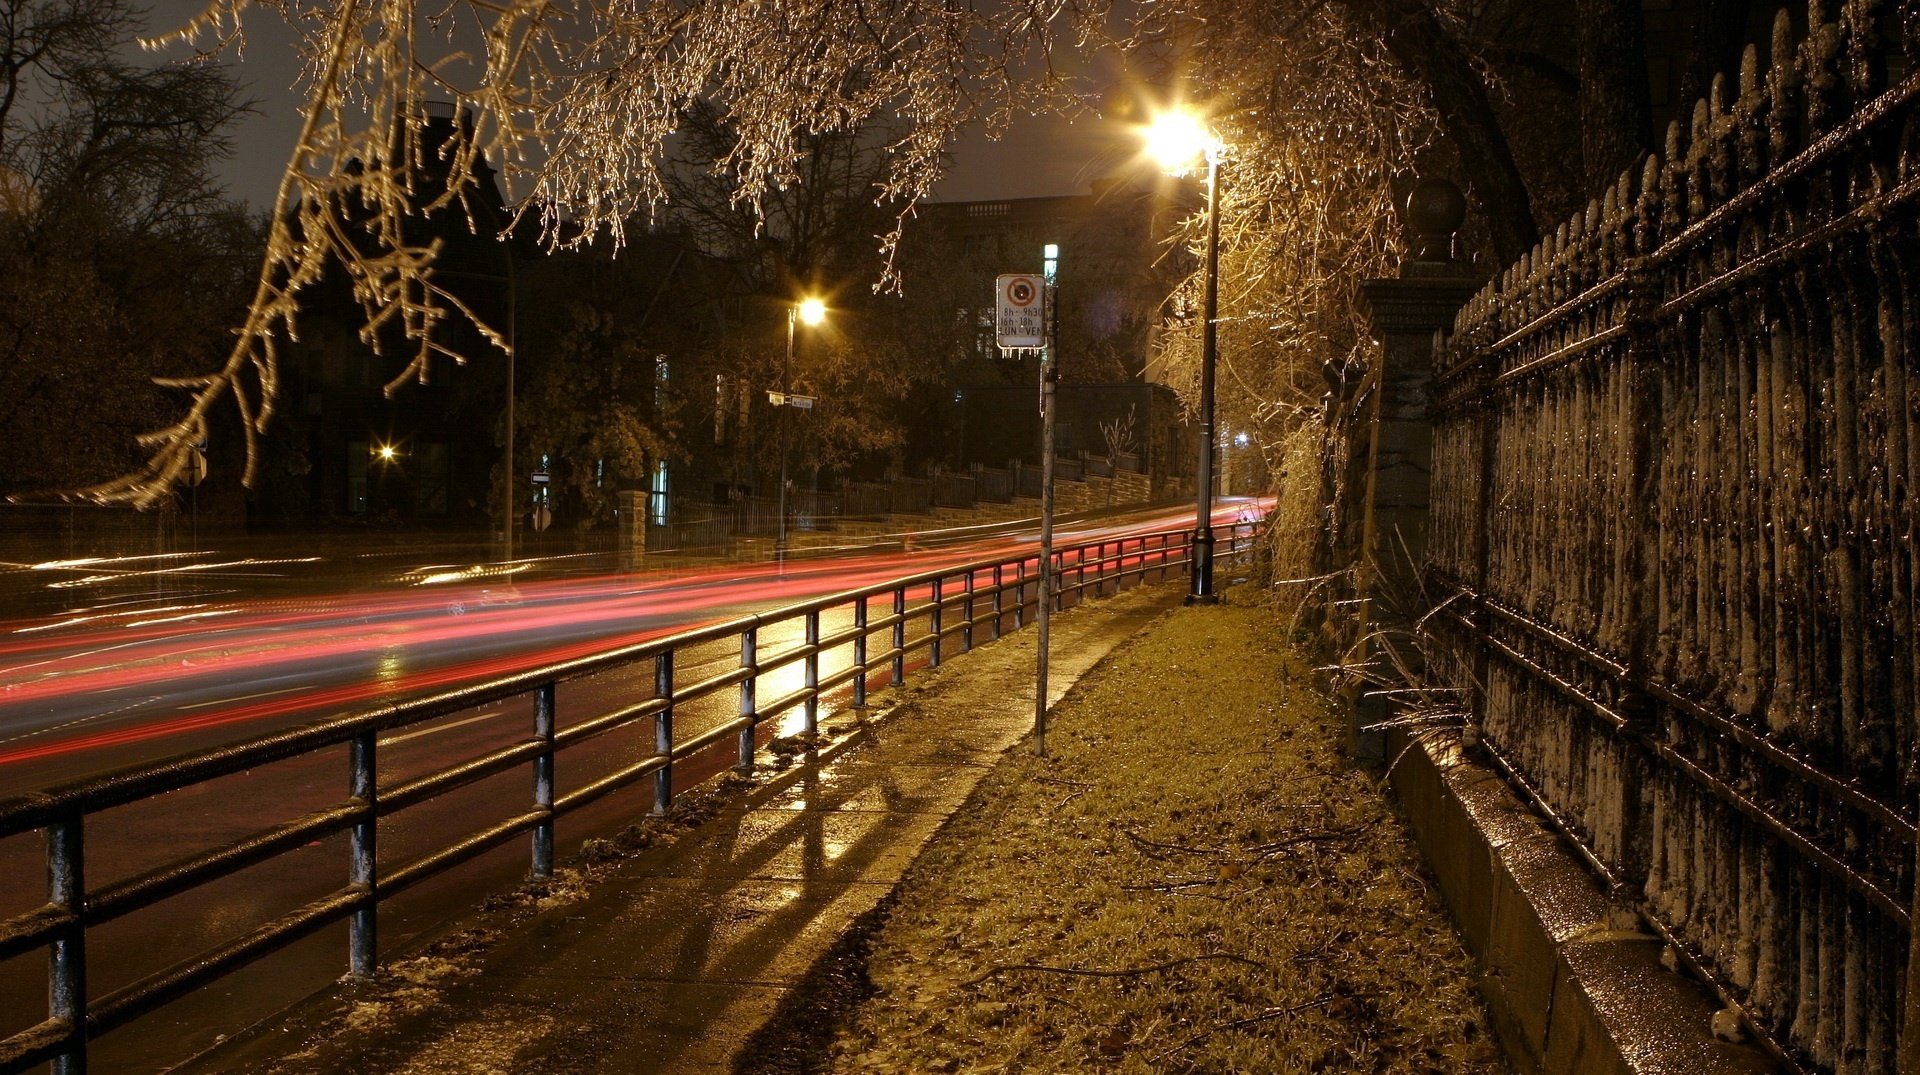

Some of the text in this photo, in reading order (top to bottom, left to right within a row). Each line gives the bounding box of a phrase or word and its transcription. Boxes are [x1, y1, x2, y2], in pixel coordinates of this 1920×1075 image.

[1004, 308, 1014, 317] 8h
[1023, 308, 1042, 317] 9h30
[1001, 317, 1014, 326] 16h
[999, 327, 1017, 336] LUN
[1025, 327, 1042, 336] VEN
